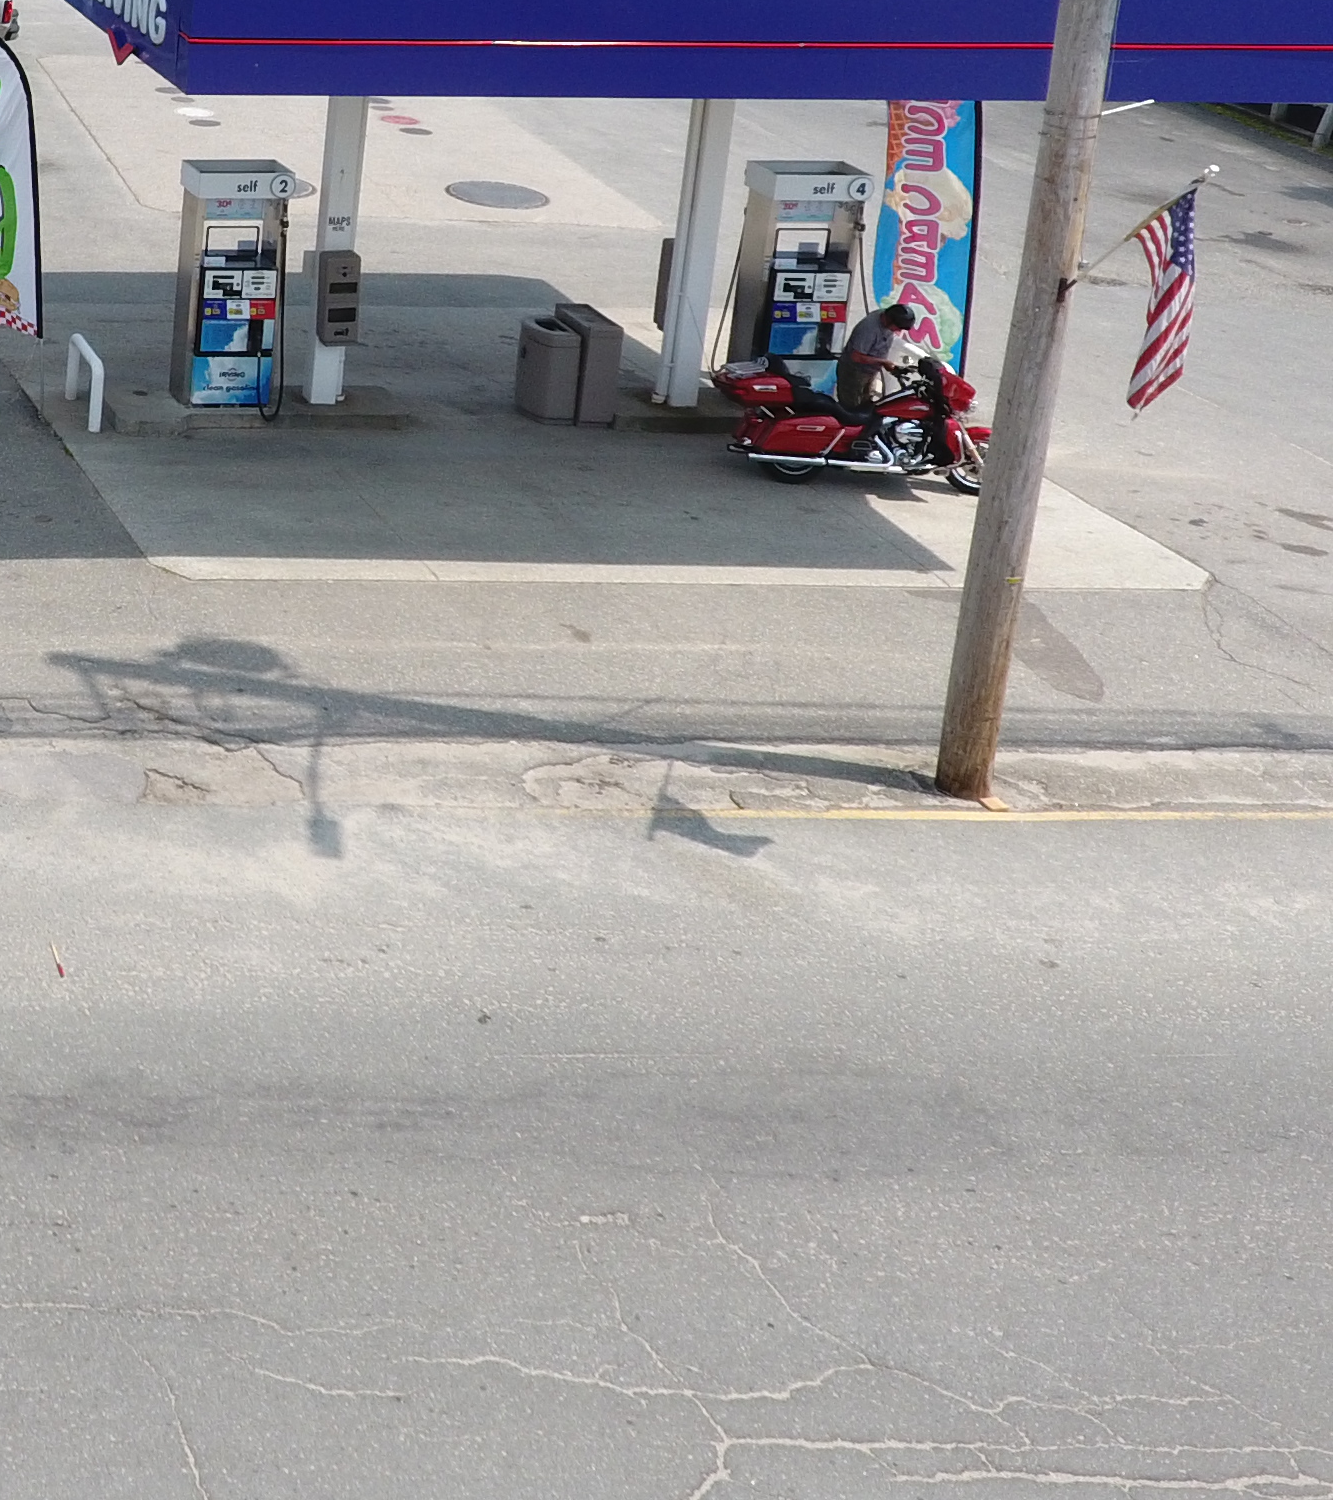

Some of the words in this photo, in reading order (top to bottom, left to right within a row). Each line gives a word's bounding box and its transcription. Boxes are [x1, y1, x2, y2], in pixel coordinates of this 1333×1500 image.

[237, 180, 258, 193] self
[279, 180, 289, 193] 2
[813, 183, 835, 195] self
[856, 183, 866, 195] 4
[329, 217, 351, 226] MAPS
